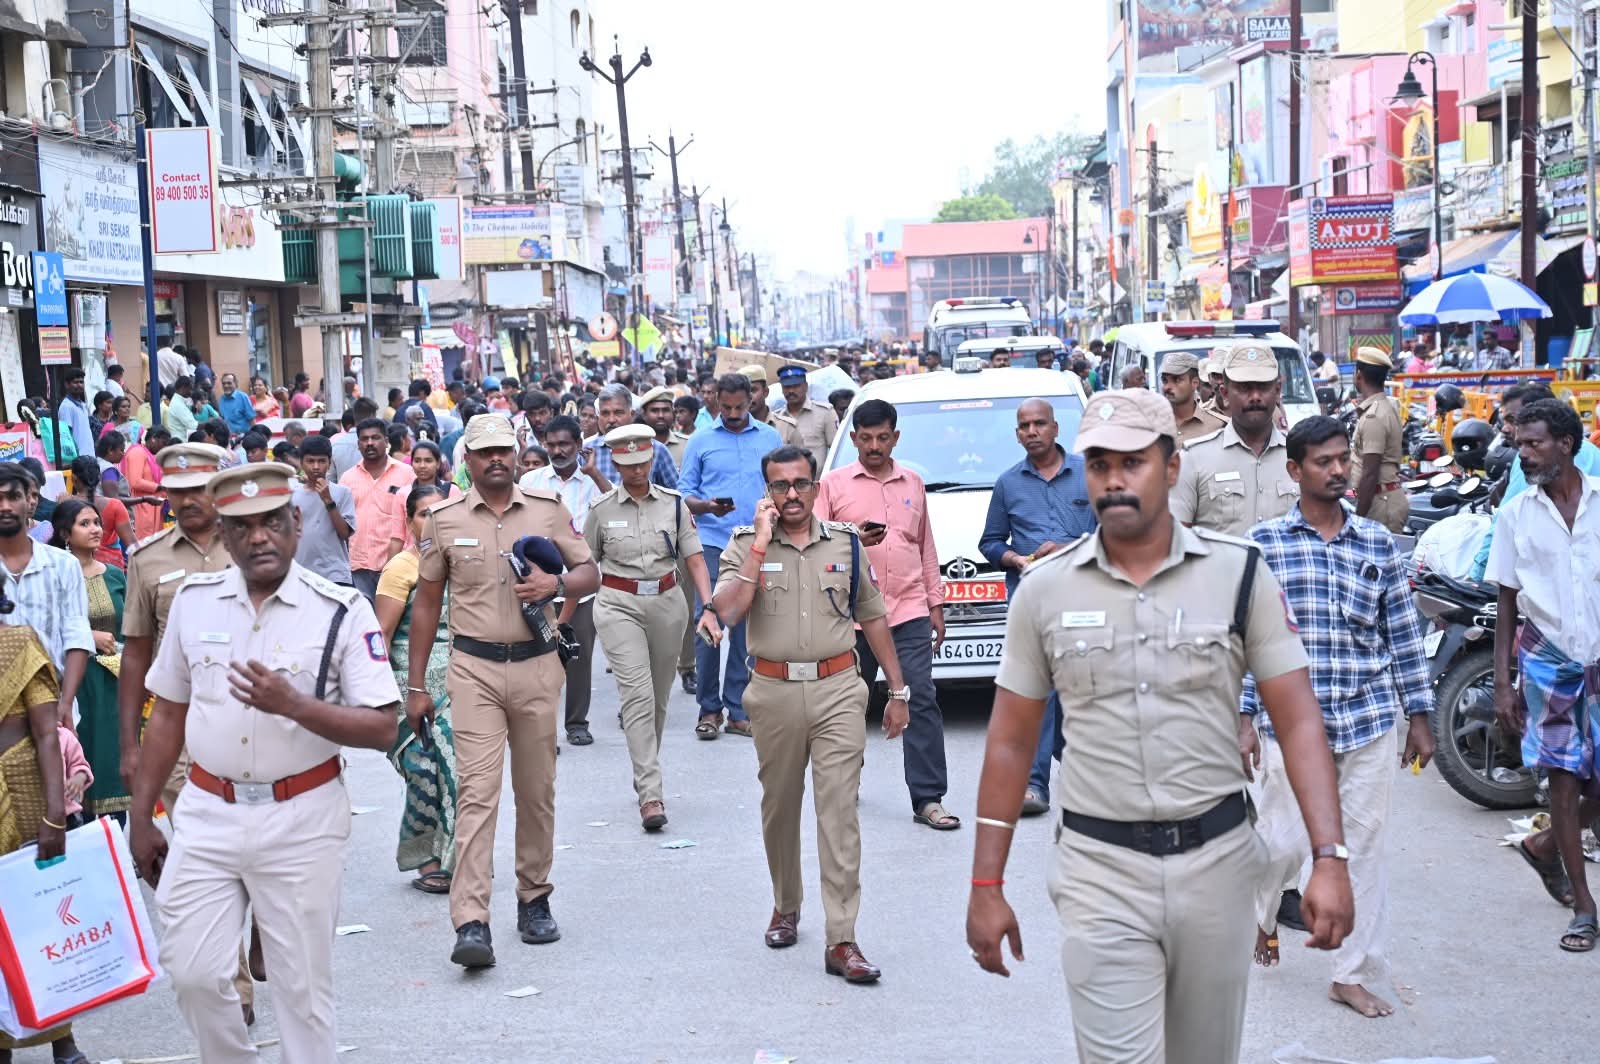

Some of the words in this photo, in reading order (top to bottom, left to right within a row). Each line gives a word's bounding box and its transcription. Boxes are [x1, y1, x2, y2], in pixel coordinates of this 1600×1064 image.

[162, 173, 201, 183] Contact
[156, 187, 165, 201] 89
[167, 186, 181, 200] 400
[183, 186, 197, 200] 500
[199, 185, 209, 199] 35
[98, 221, 109, 236] SRI
[110, 223, 130, 238] SEKAR
[472, 223, 485, 232] The
[88, 240, 105, 259] KHADI
[34, 256, 48, 293] P
